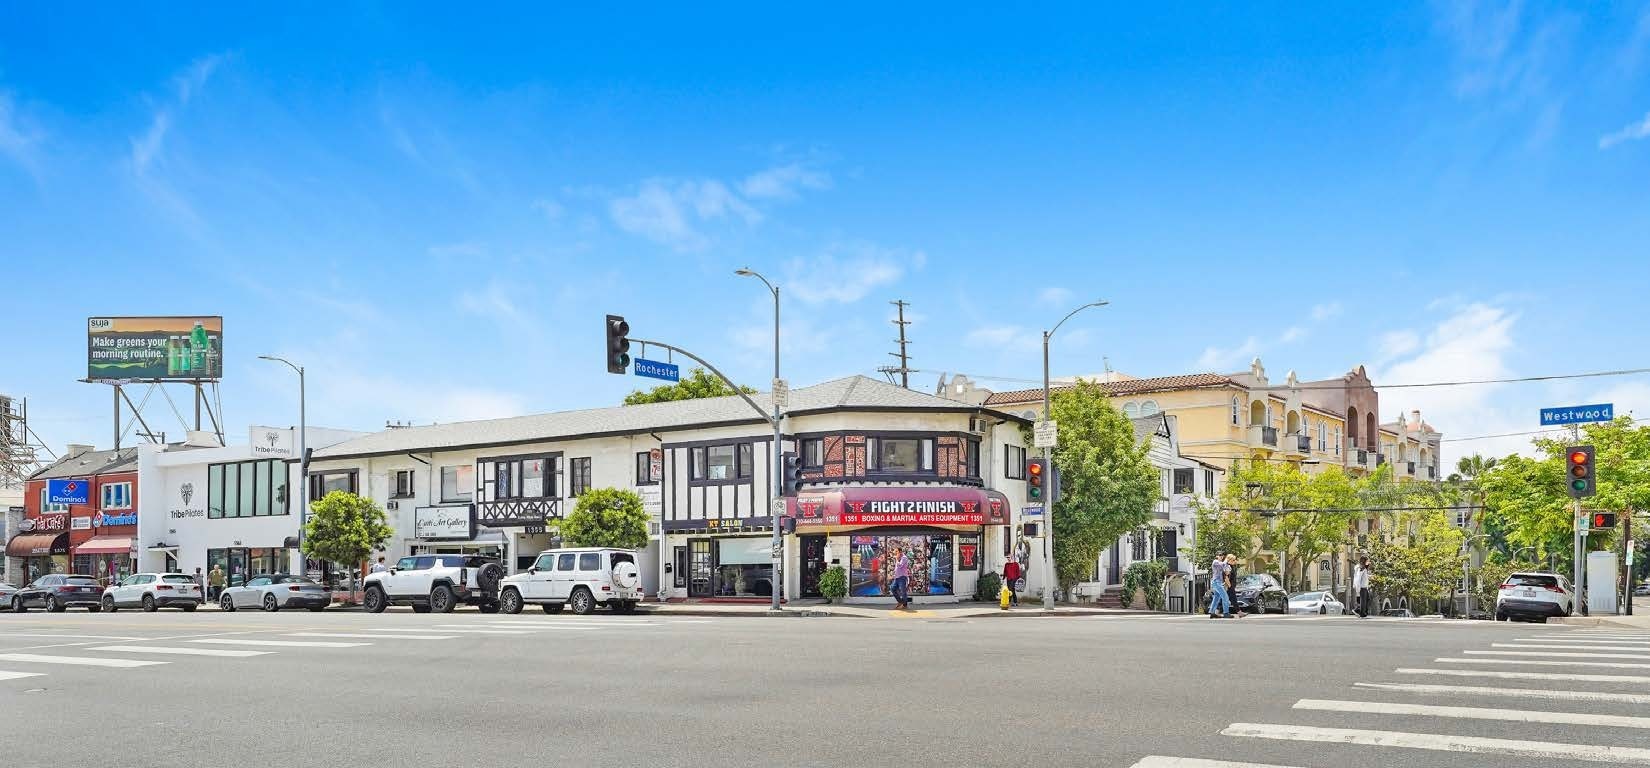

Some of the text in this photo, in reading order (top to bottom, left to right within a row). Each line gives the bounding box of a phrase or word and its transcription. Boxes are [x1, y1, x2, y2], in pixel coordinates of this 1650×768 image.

[90, 319, 109, 328] suja
[92, 337, 167, 348] Make greens your
[92, 350, 164, 360] morning routine.
[635, 362, 678, 378] Rochester
[1543, 408, 1609, 421] Westwood
[52, 495, 86, 503] Domino's
[871, 501, 956, 513] FIGHT 2 FINISH
[103, 512, 137, 525] Domino's
[446, 518, 467, 529] Gallery
[720, 519, 743, 527] SALON
